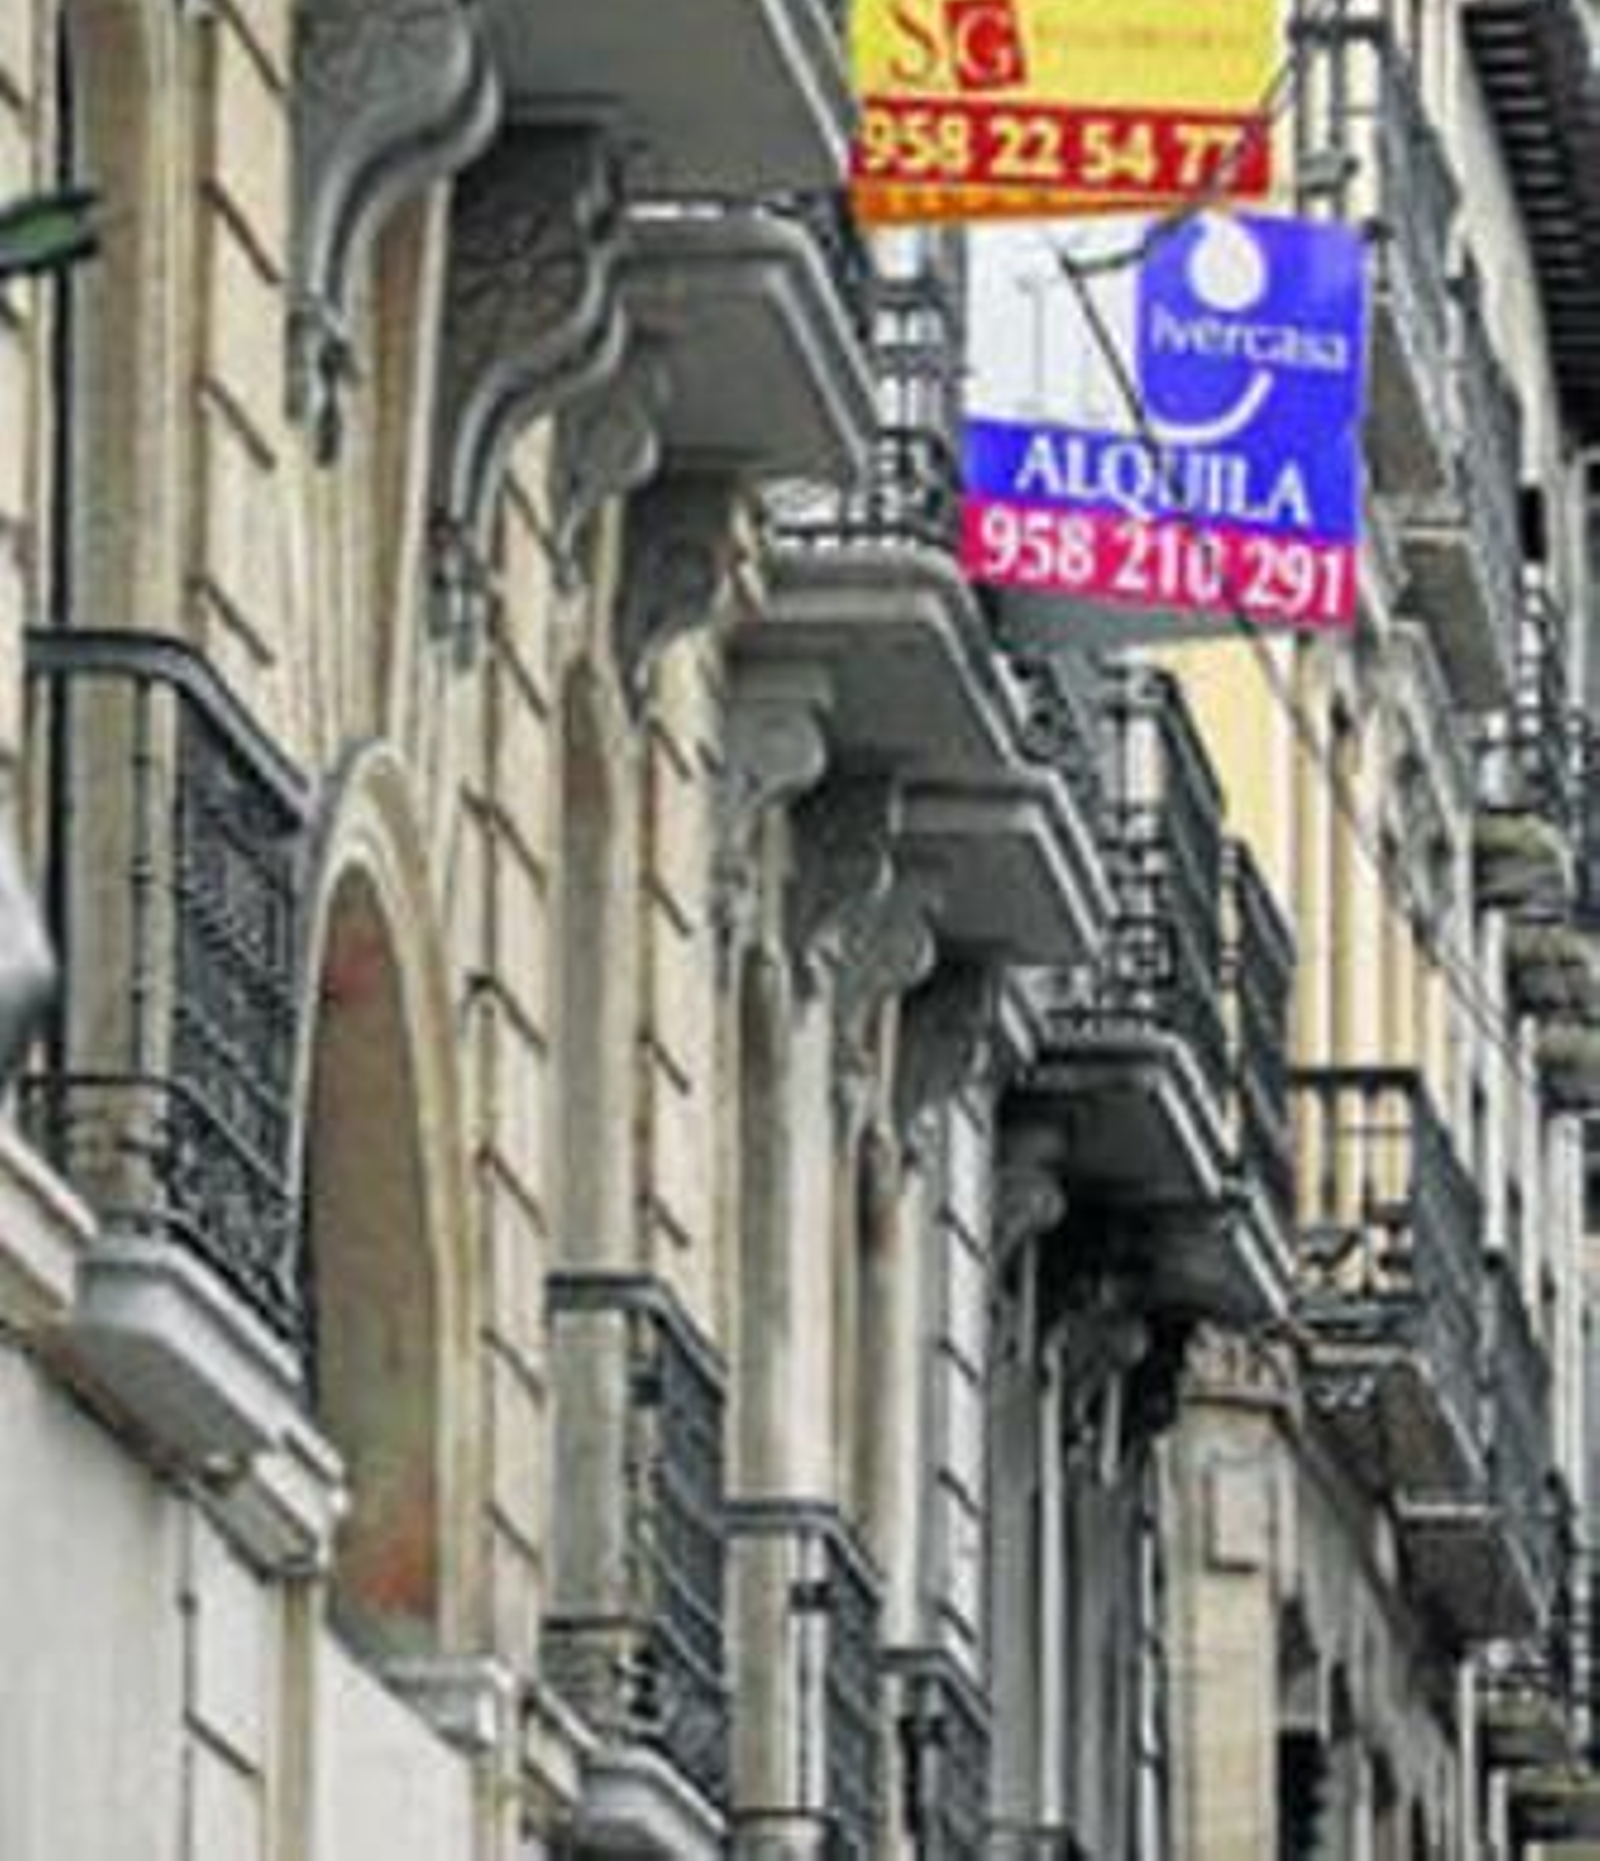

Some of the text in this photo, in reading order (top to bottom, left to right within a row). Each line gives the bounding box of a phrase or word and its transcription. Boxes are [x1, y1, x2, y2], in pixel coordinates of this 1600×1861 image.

[862, 109, 1245, 186] 958 22 54 77
[1014, 432, 1314, 524] ALQUILA
[980, 506, 1344, 618] 958 210 291
